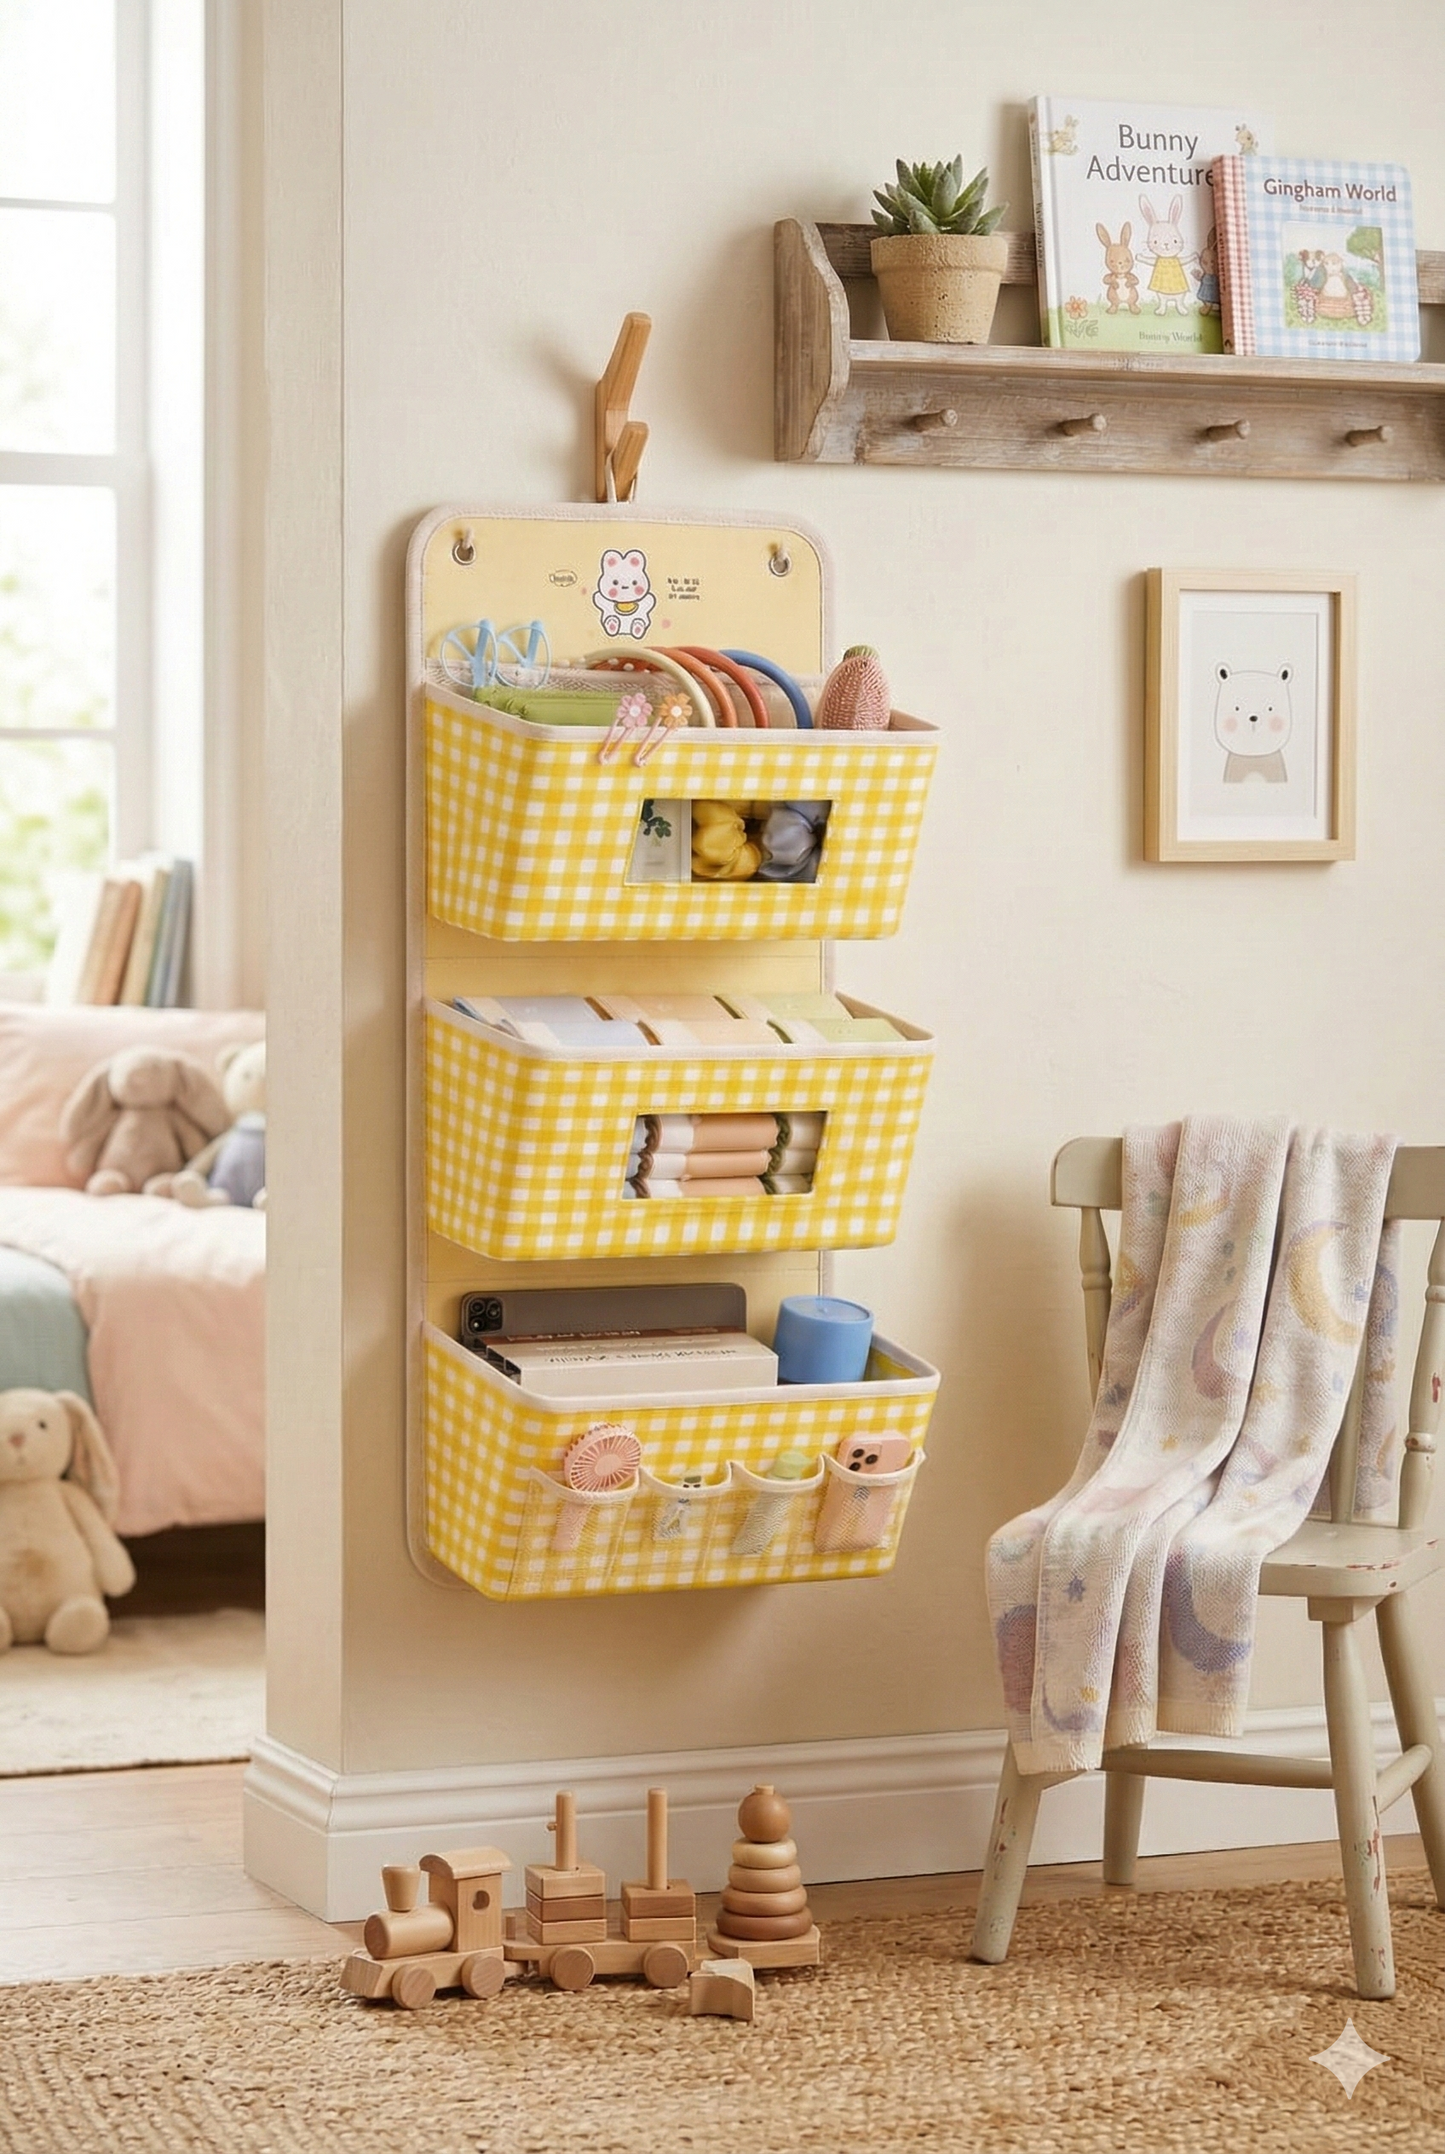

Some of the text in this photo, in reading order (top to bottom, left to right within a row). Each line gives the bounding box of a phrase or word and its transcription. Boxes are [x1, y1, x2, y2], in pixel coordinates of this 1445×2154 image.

[1118, 123, 1198, 160] Bunny
[1263, 178, 1397, 202] Gingham World
